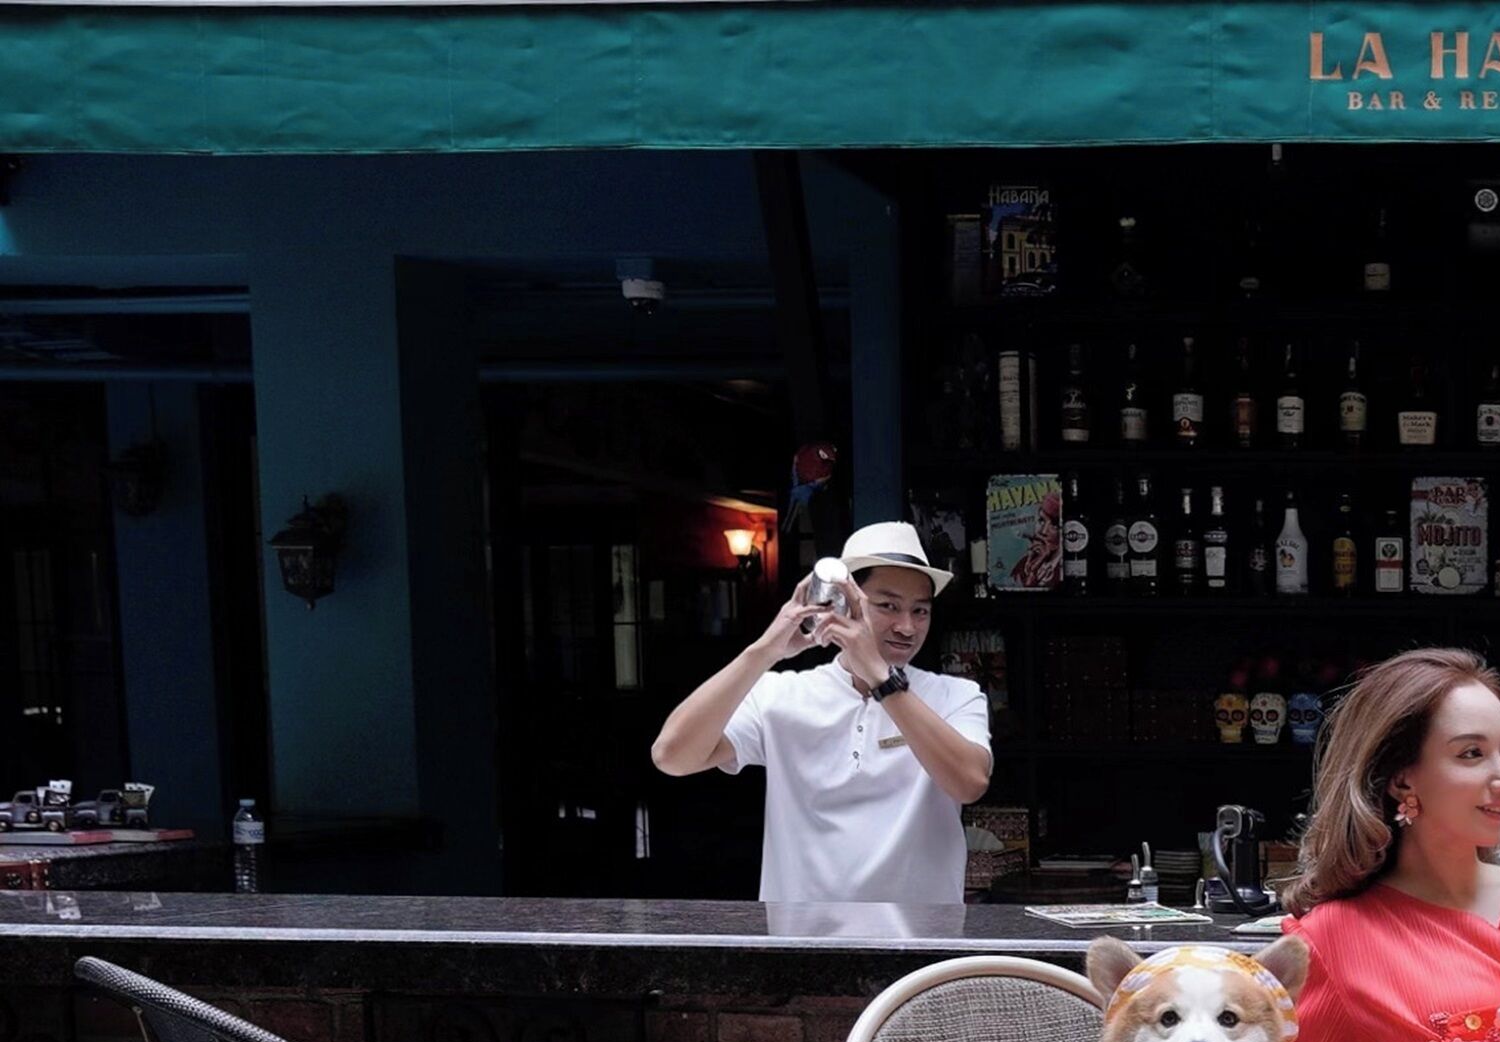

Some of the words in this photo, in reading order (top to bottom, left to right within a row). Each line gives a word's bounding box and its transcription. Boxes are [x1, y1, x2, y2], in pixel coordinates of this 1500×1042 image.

[1308, 31, 1393, 81] LA
[1347, 91, 1406, 111] BAR
[1423, 92, 1442, 110] &
[1417, 525, 1482, 546] MOJITO
